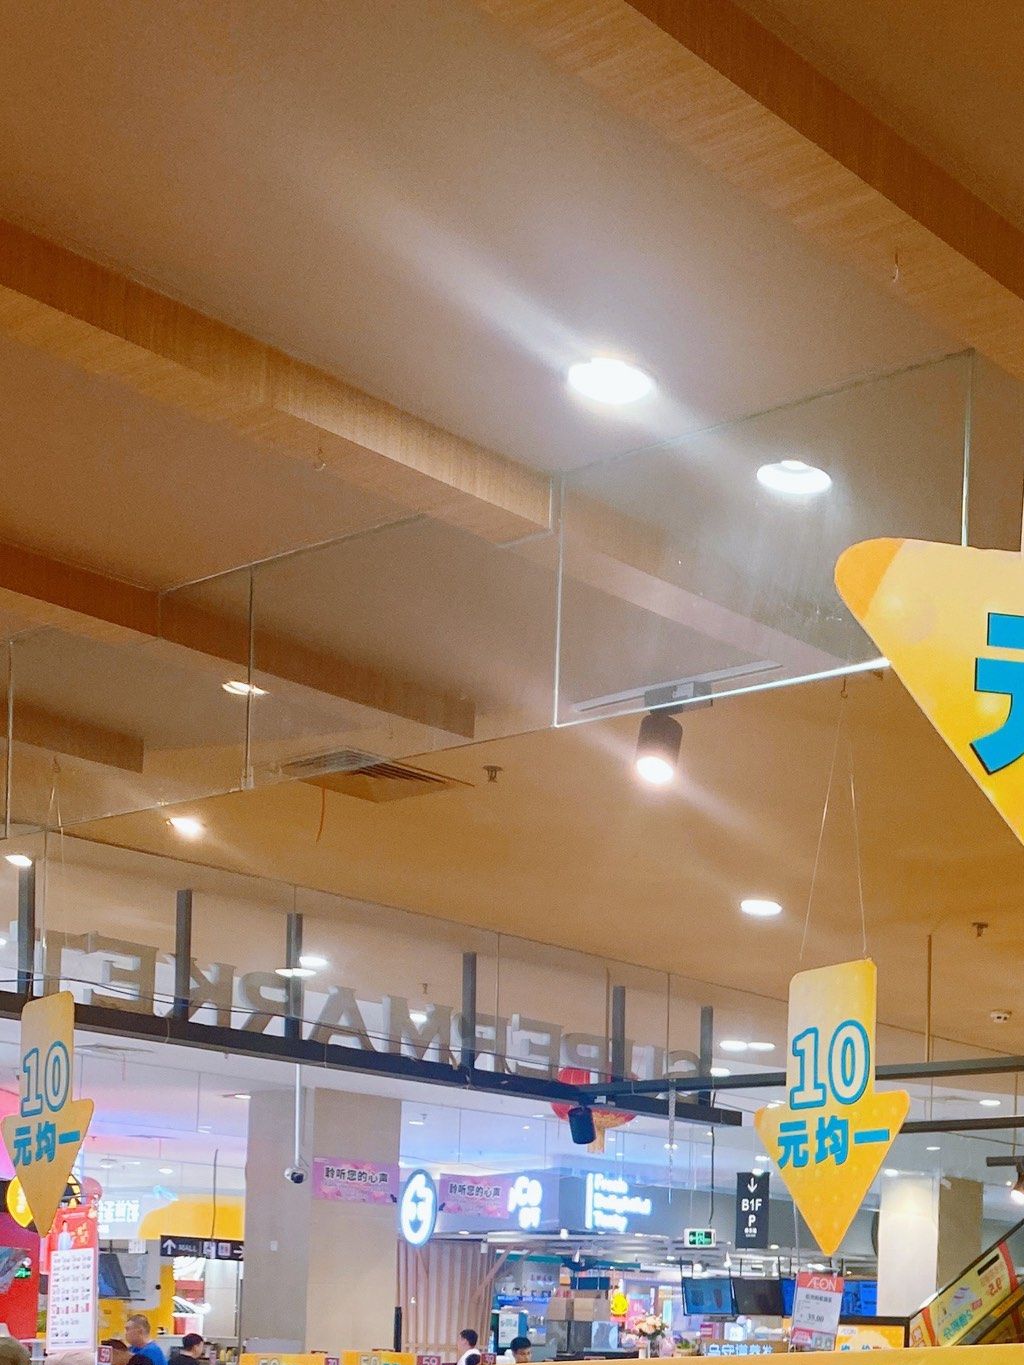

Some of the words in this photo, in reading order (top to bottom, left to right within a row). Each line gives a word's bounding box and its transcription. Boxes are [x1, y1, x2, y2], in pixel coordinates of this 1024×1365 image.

[20, 1040, 70, 1118] 10
[789, 1018, 871, 1111] 10
[12, 1119, 81, 1167] 元均一
[776, 1114, 890, 1169] 元均一
[325, 1165, 389, 1184] 聆听您的心声
[742, 1199, 762, 1212] B1F
[748, 1214, 756, 1227] P
